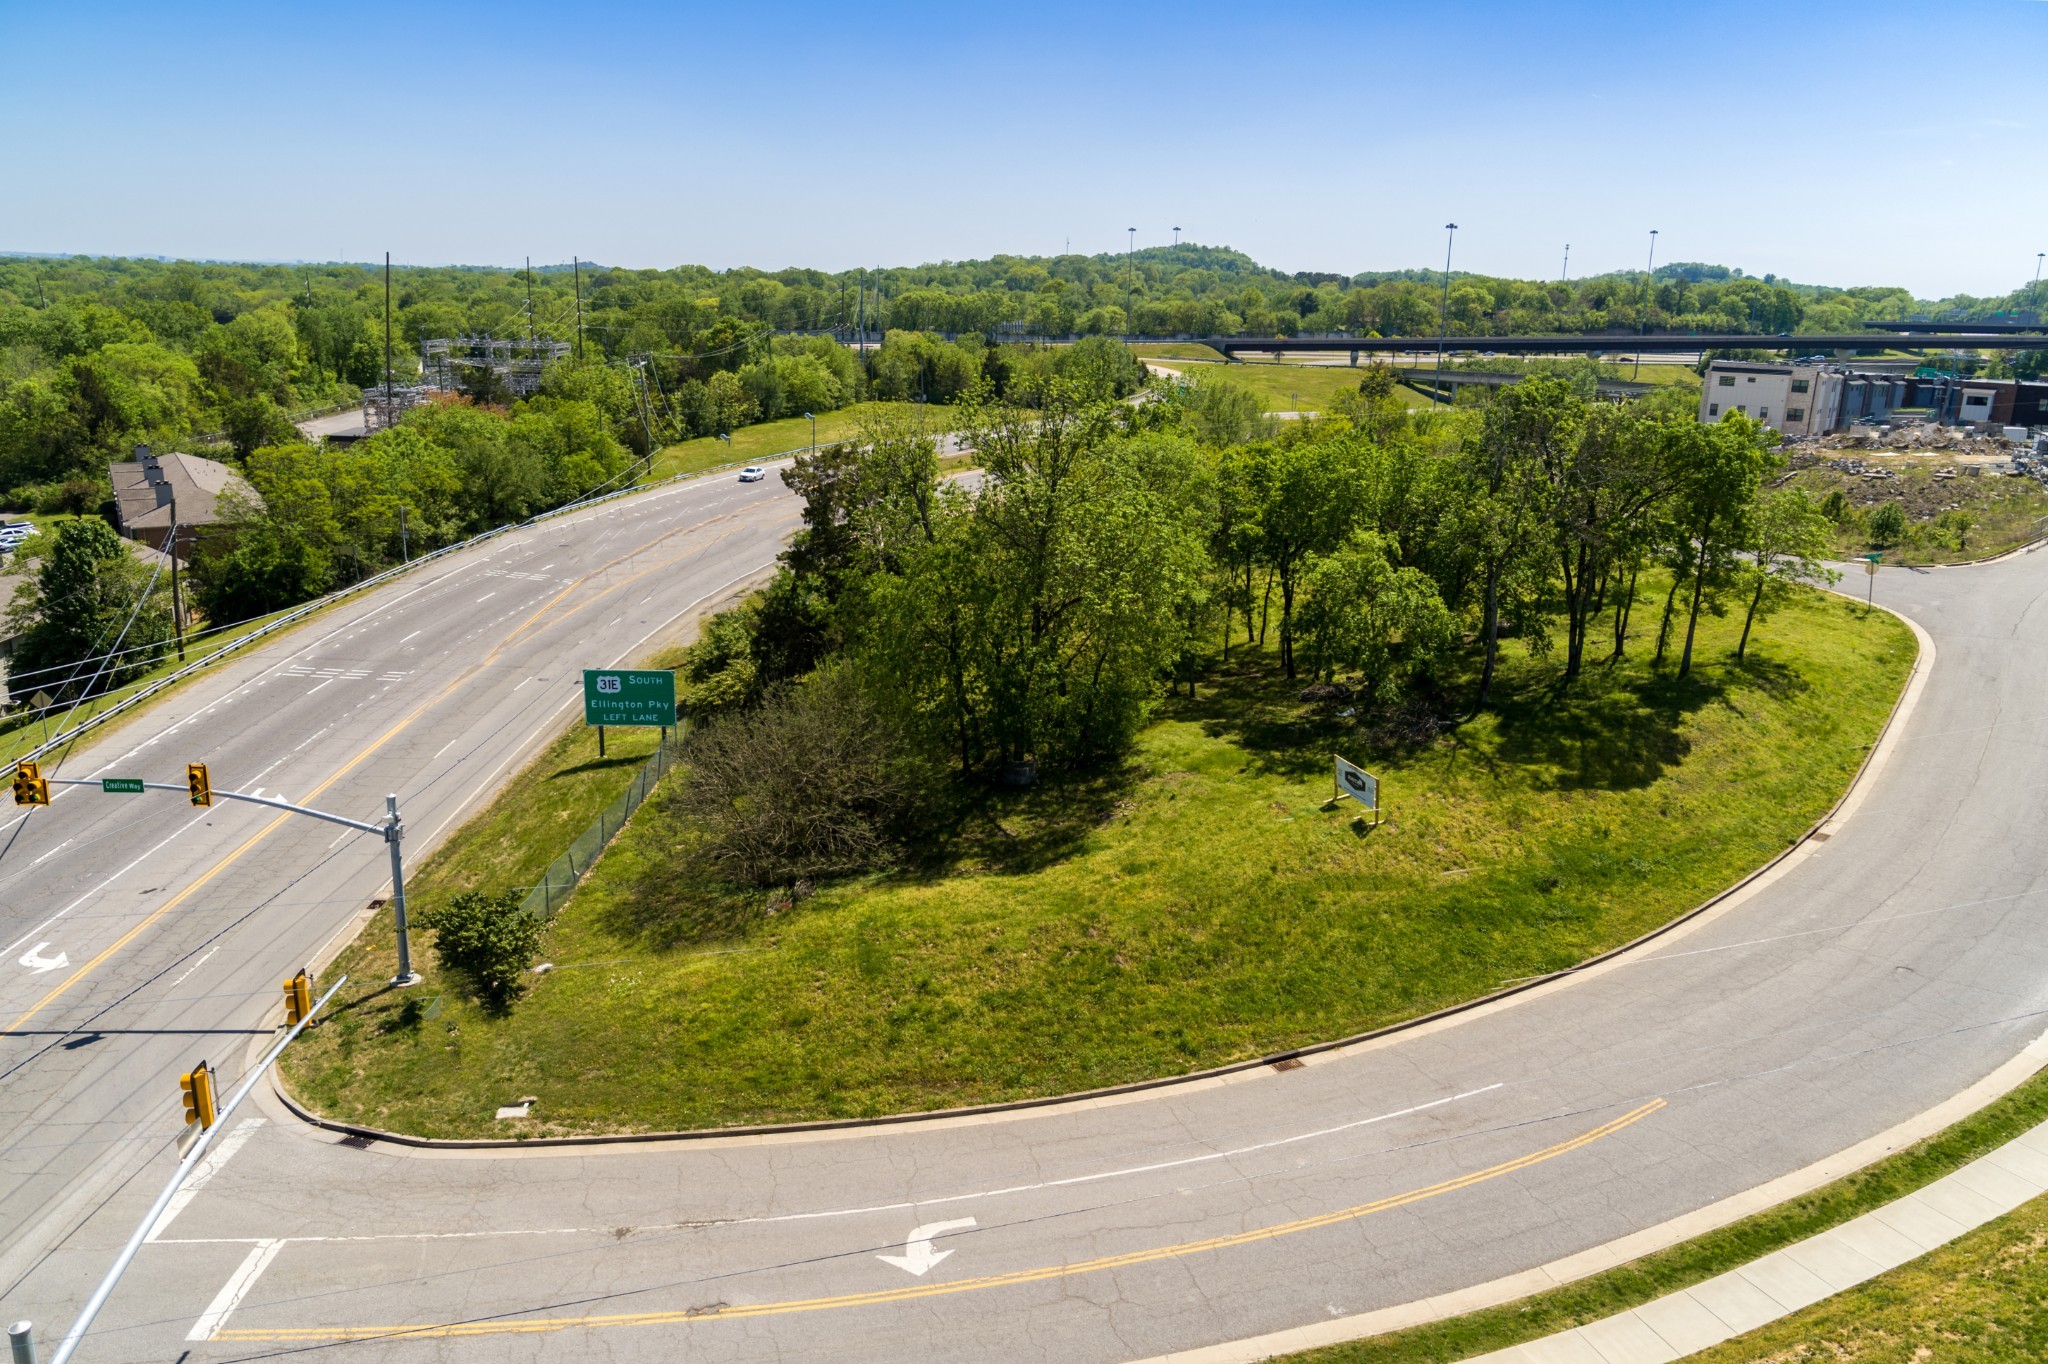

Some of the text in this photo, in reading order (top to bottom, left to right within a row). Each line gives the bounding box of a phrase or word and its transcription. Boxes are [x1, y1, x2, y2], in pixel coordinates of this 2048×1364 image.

[600, 679, 618, 690] 31E
[629, 675, 663, 684] SOUTH
[591, 700, 669, 710] Ellington Pky
[105, 781, 141, 791] Creative Way
